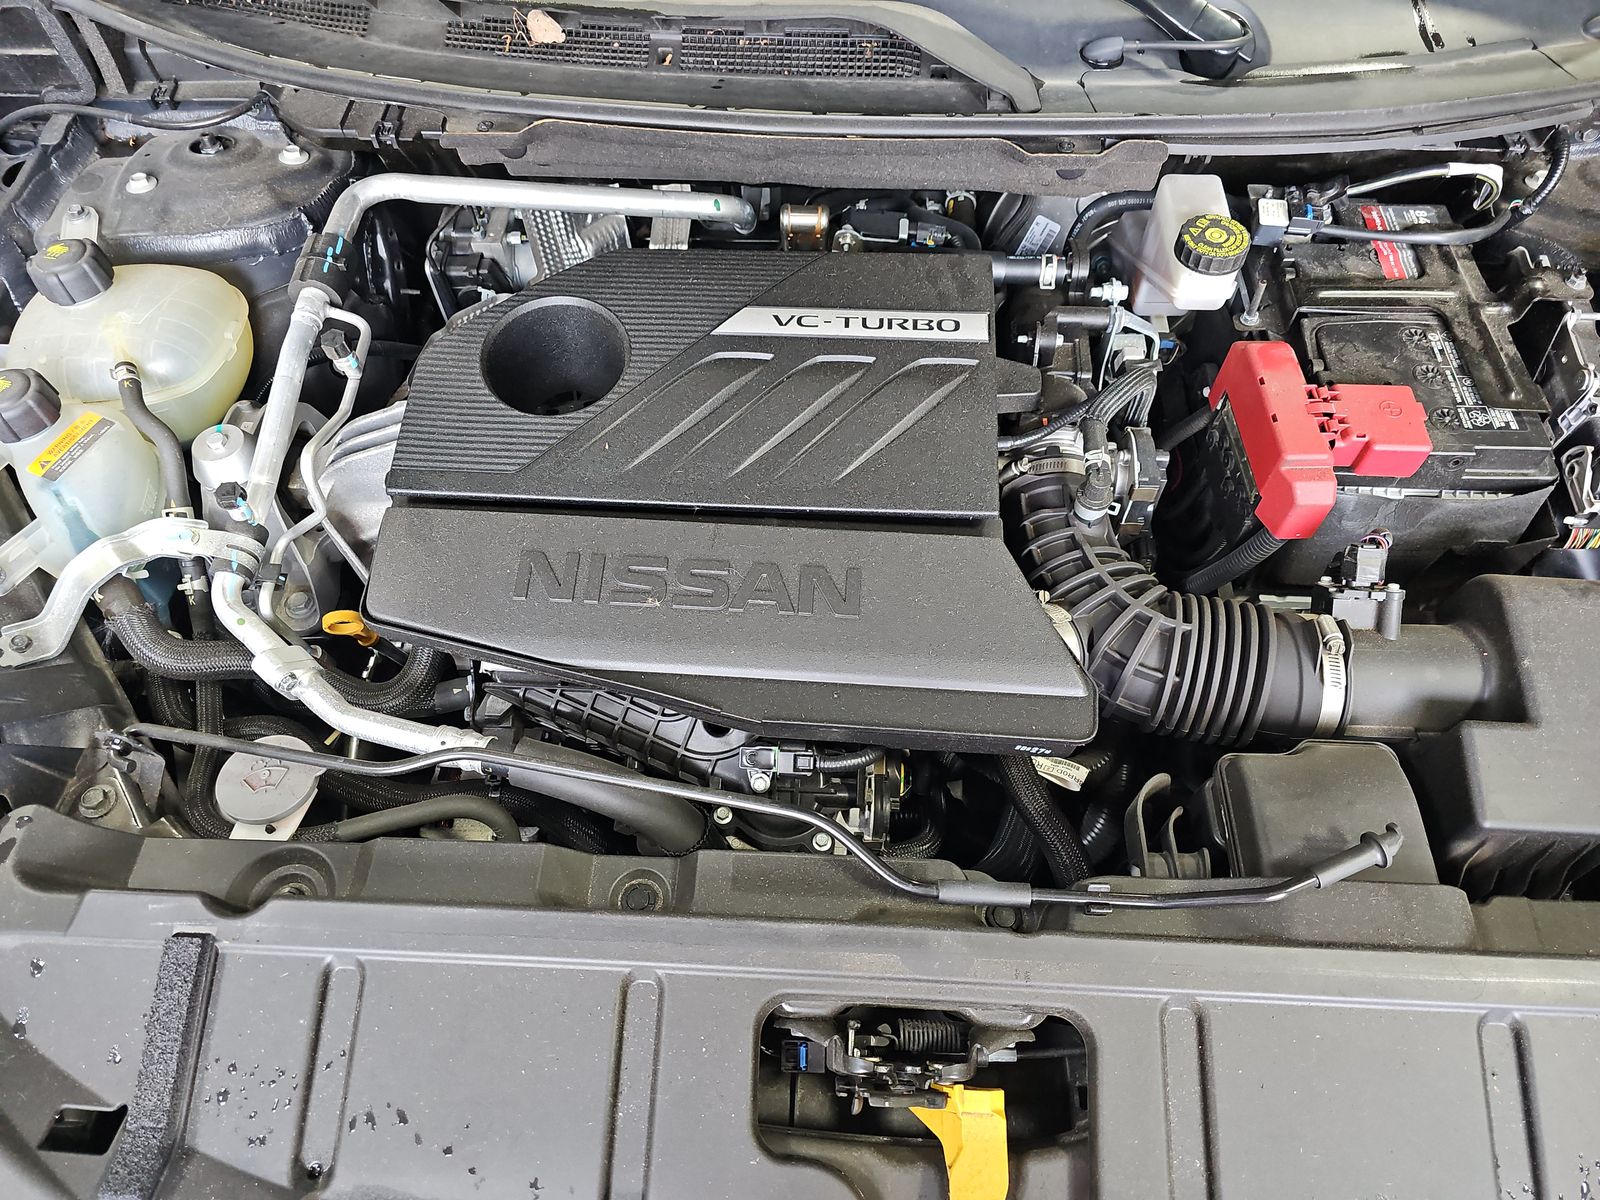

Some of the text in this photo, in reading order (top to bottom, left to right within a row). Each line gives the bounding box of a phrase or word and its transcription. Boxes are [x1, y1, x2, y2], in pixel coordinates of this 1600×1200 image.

[1415, 209, 1430, 225] 84
[772, 314, 961, 333] VC-TURBO
[124, 380, 133, 388] K
[512, 550, 862, 619] NISSAN
[188, 595, 196, 606] K
